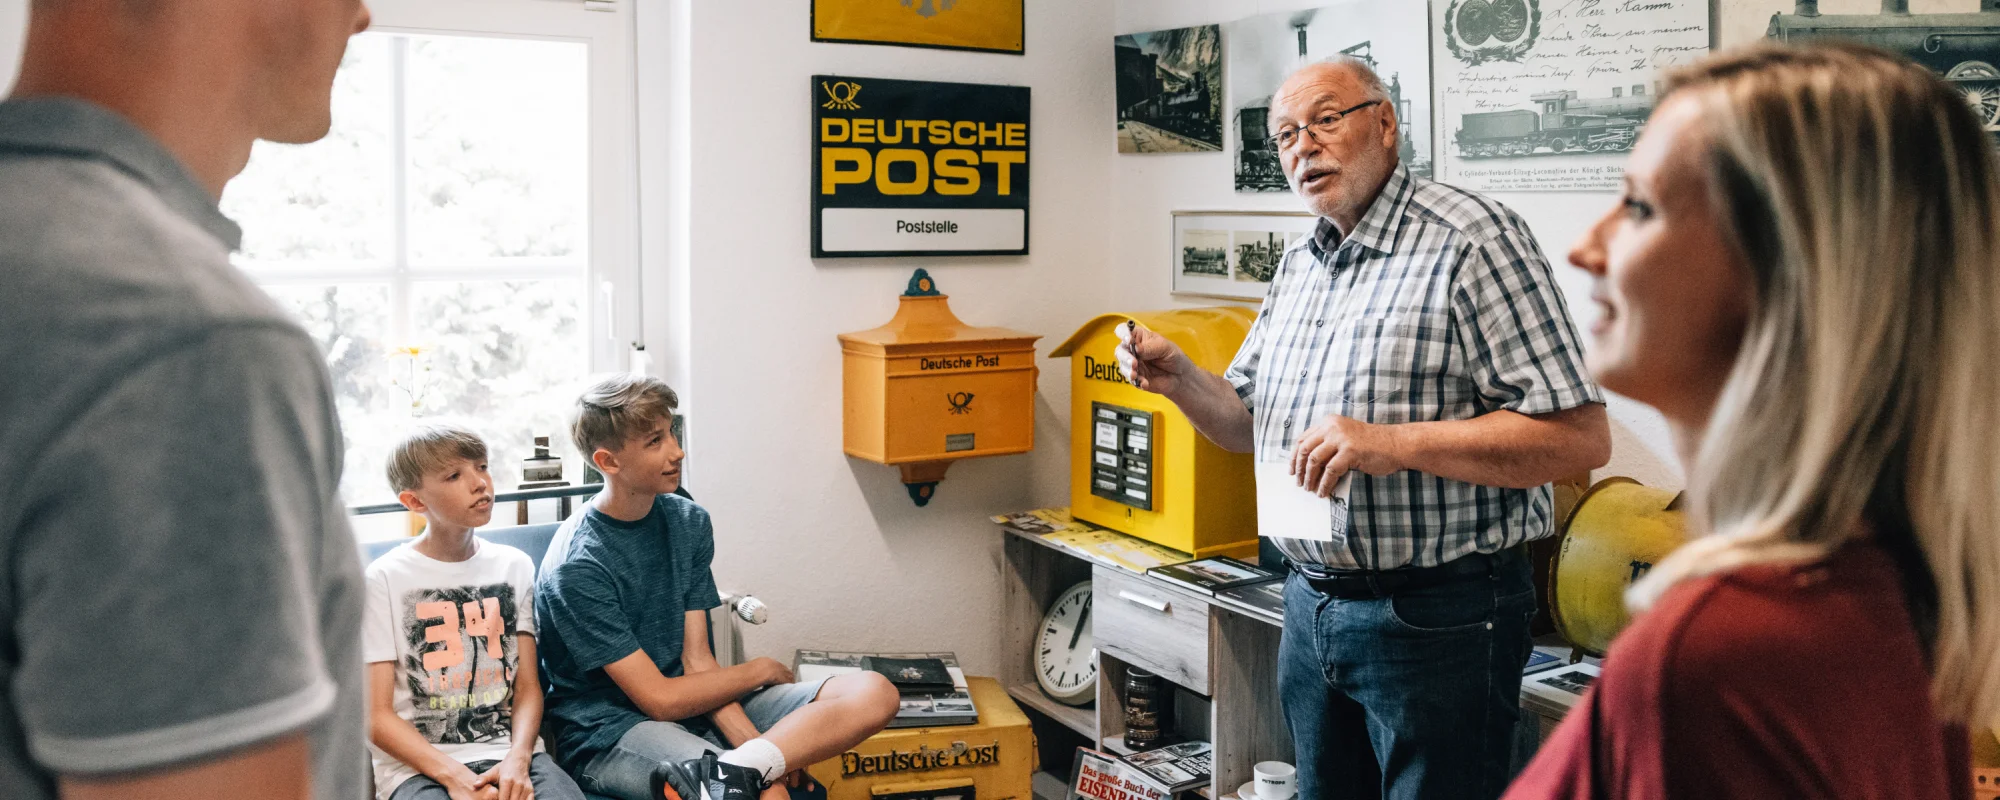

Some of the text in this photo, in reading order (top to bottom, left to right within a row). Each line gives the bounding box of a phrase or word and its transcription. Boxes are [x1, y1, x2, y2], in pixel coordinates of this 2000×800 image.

[821, 118, 1026, 146] DEUTSCHE
[821, 147, 1026, 195] POST
[896, 220, 958, 233] Poststelle
[920, 354, 999, 370] Deutsche Post
[415, 597, 505, 671] 34
[429, 694, 476, 710] BEACH
[842, 739, 999, 778] Deutsche Post
[1082, 764, 1097, 777] Das
[1098, 772, 1123, 787] große
[1123, 779, 1145, 796] Buch
[1146, 788, 1161, 800] der
